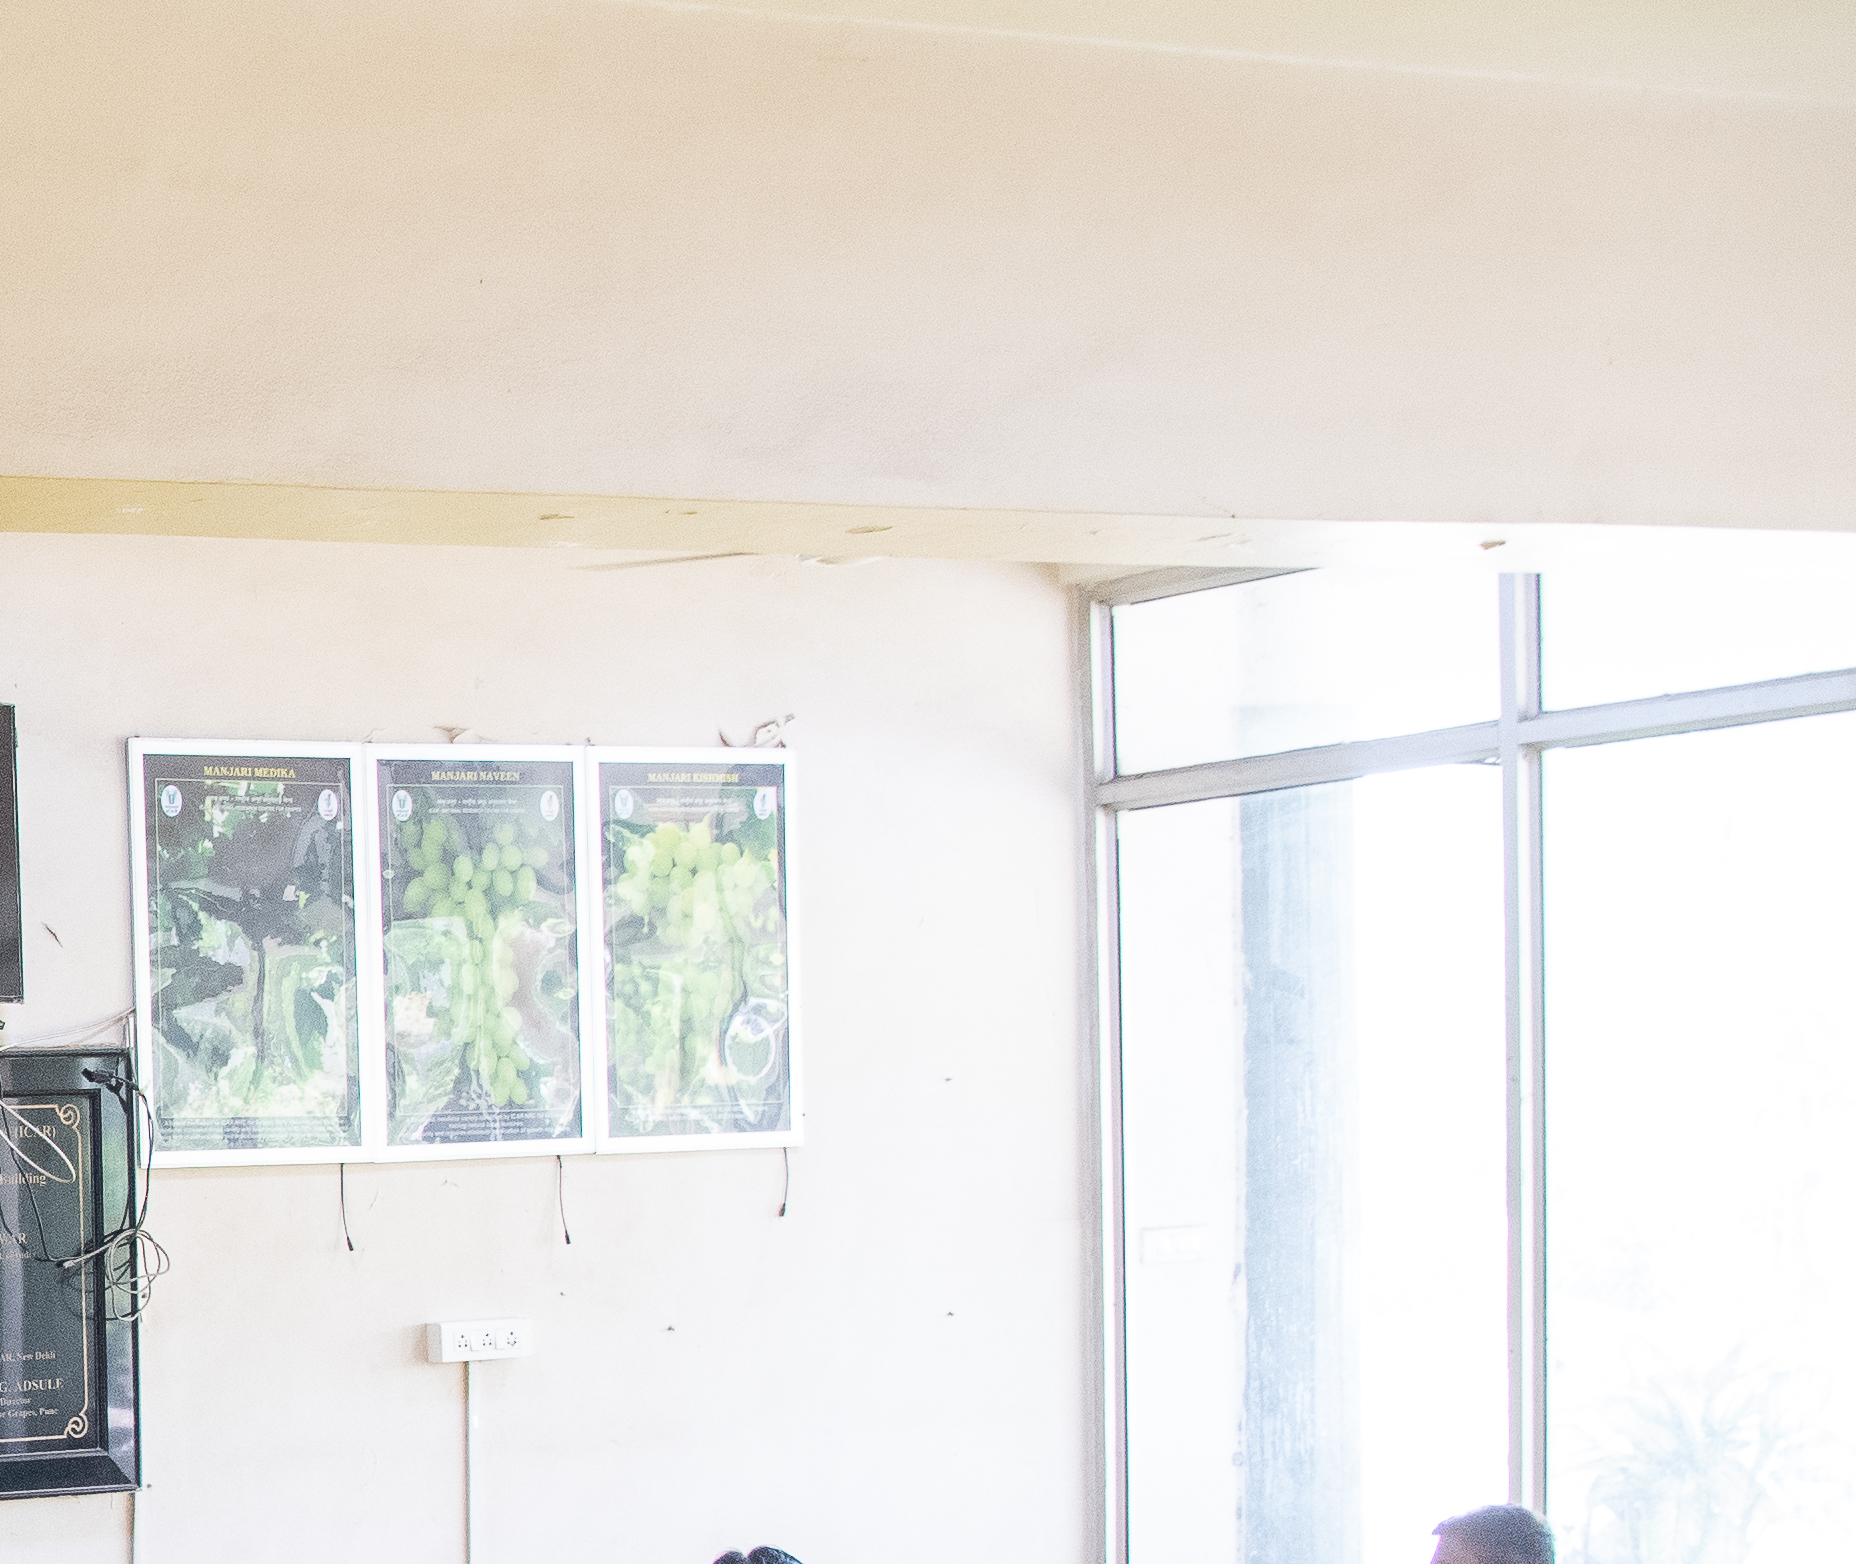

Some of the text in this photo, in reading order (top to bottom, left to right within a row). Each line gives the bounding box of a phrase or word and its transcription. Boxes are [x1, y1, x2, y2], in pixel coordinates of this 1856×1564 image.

[203, 766, 296, 778] MANJARI MEDIKA
[431, 771, 478, 781] MANJARI
[0, 1380, 11, 1392] G.
